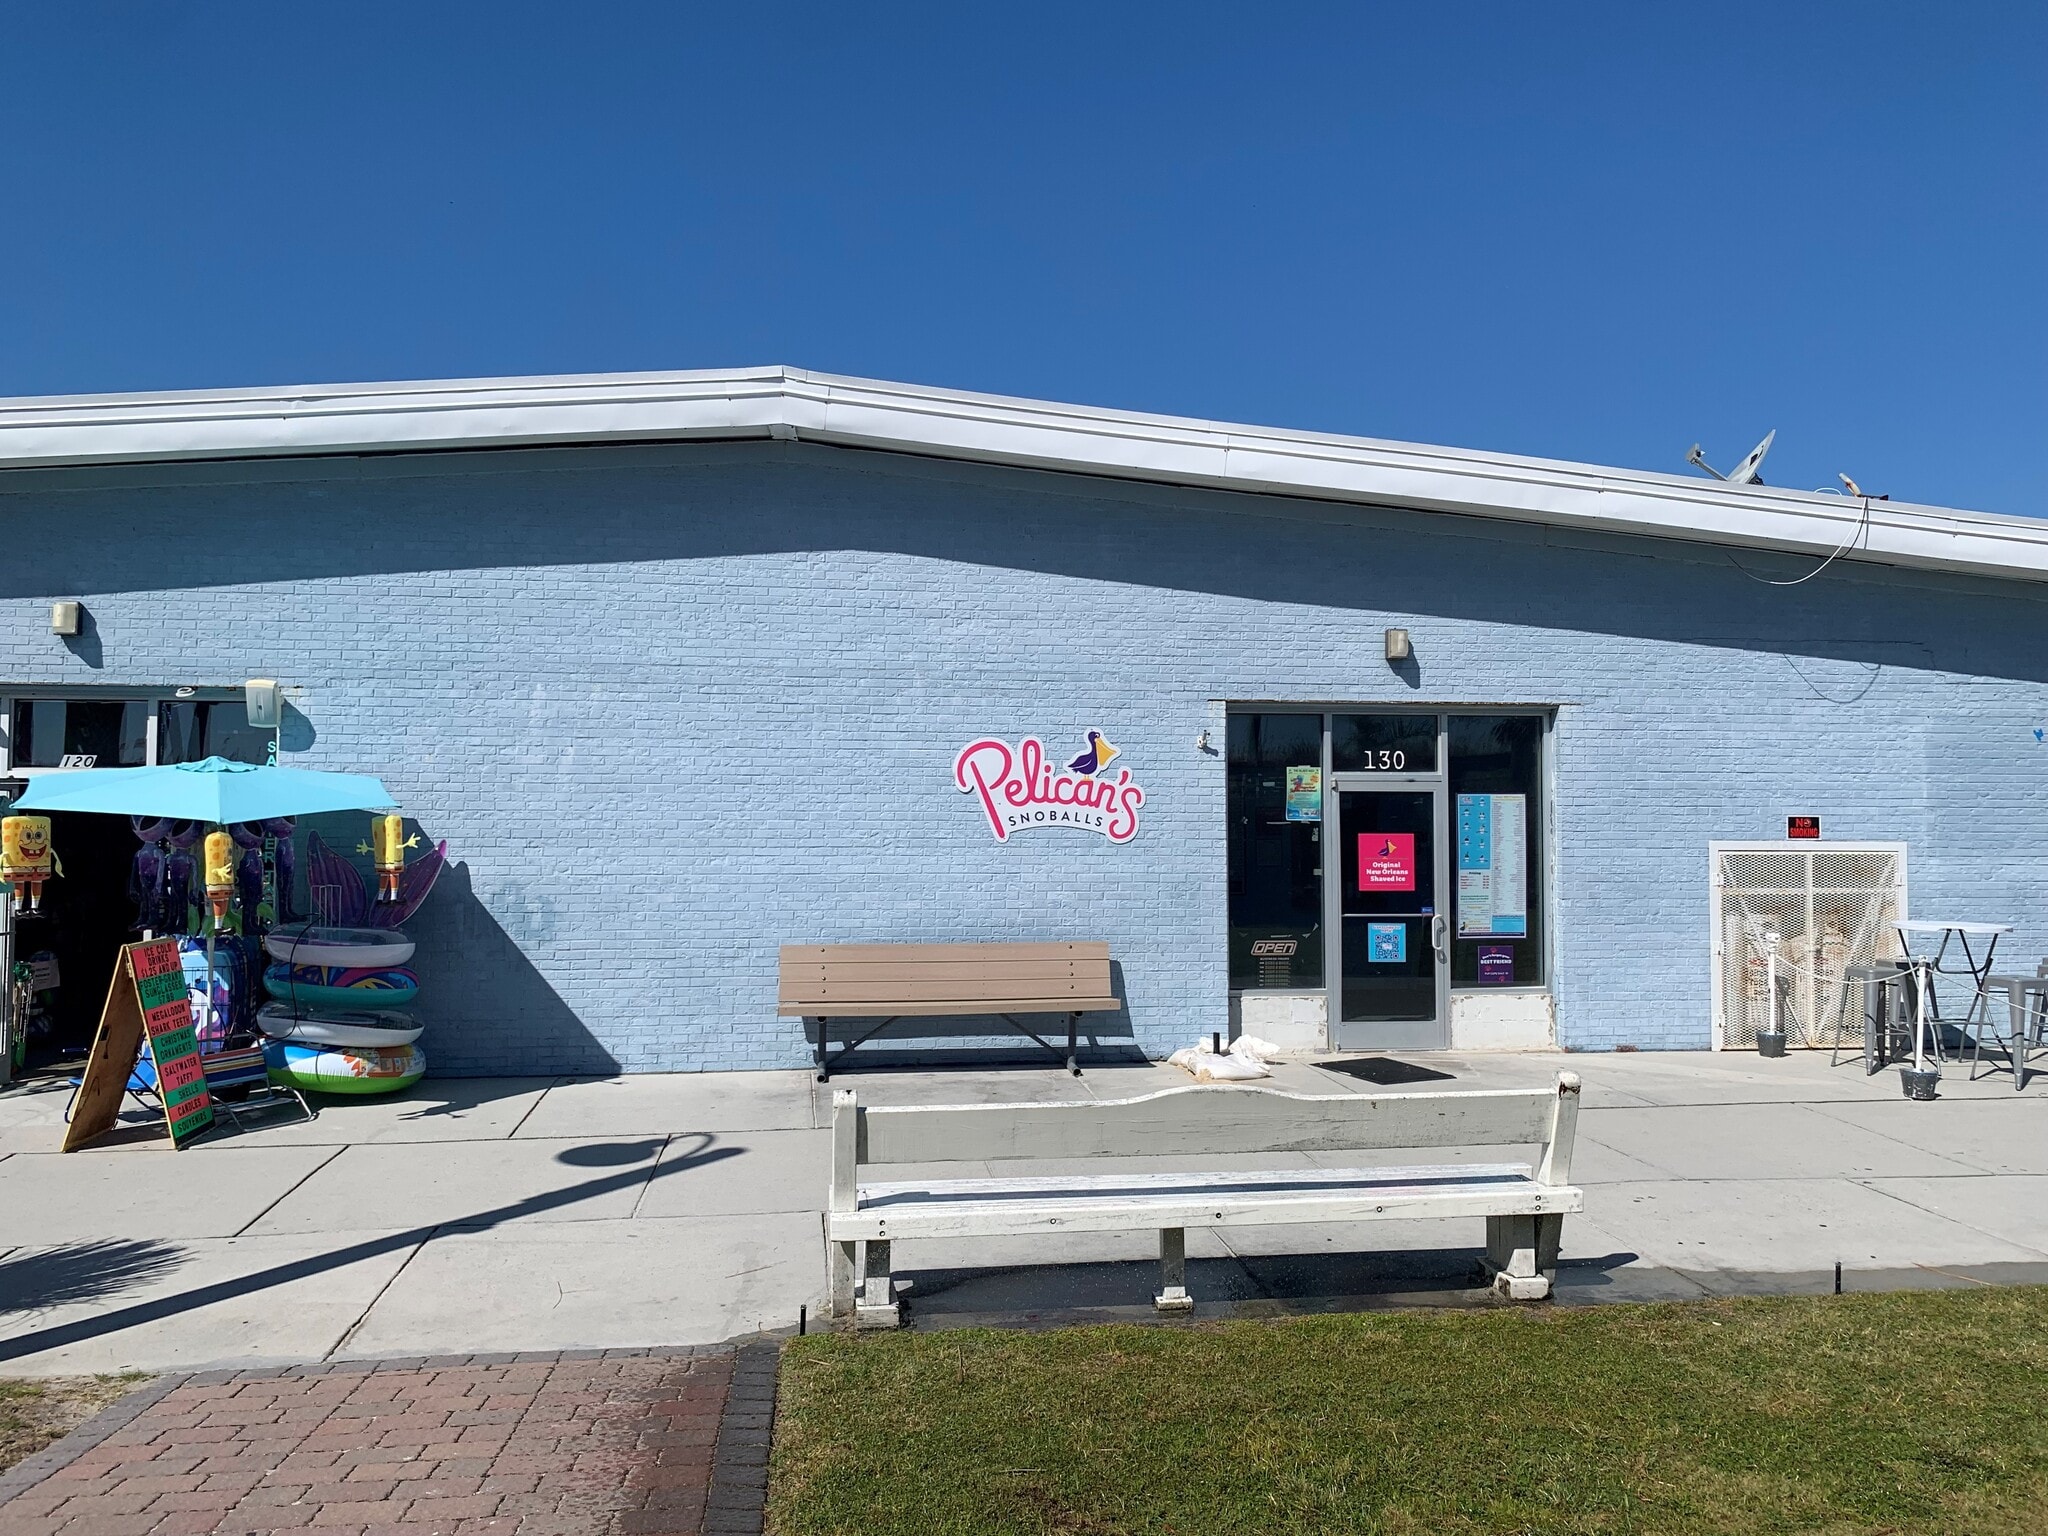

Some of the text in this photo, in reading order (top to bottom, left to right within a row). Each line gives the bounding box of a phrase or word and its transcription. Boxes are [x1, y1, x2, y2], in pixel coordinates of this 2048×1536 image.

[63, 755, 94, 768] 120
[1364, 750, 1405, 770] 130
[956, 739, 1142, 840] Pelican's
[1008, 810, 1103, 826] SNOBALLS
[1790, 827, 1818, 838] SMOKING
[1372, 861, 1401, 869] Original
[144, 943, 172, 958] ICE COLD
[1254, 943, 1294, 953] OPEN
[147, 953, 170, 967] DRINKS
[159, 963, 169, 974] AND
[170, 961, 178, 971] UP
[145, 980, 183, 999] SUNGLASSES
[151, 1003, 186, 1022] MEGALODON
[151, 1015, 190, 1036] SHARK TEETH
[161, 1028, 191, 1047] CHRISTMAS
[160, 1041, 193, 1060] ORNAMENTS
[164, 1056, 198, 1077] SALTWATER
[176, 1071, 194, 1087] TAFFY
[178, 1083, 199, 1100] SHELLS
[177, 1097, 202, 1117] CANDLES
[177, 1111, 207, 1133] SOUVENIRS
